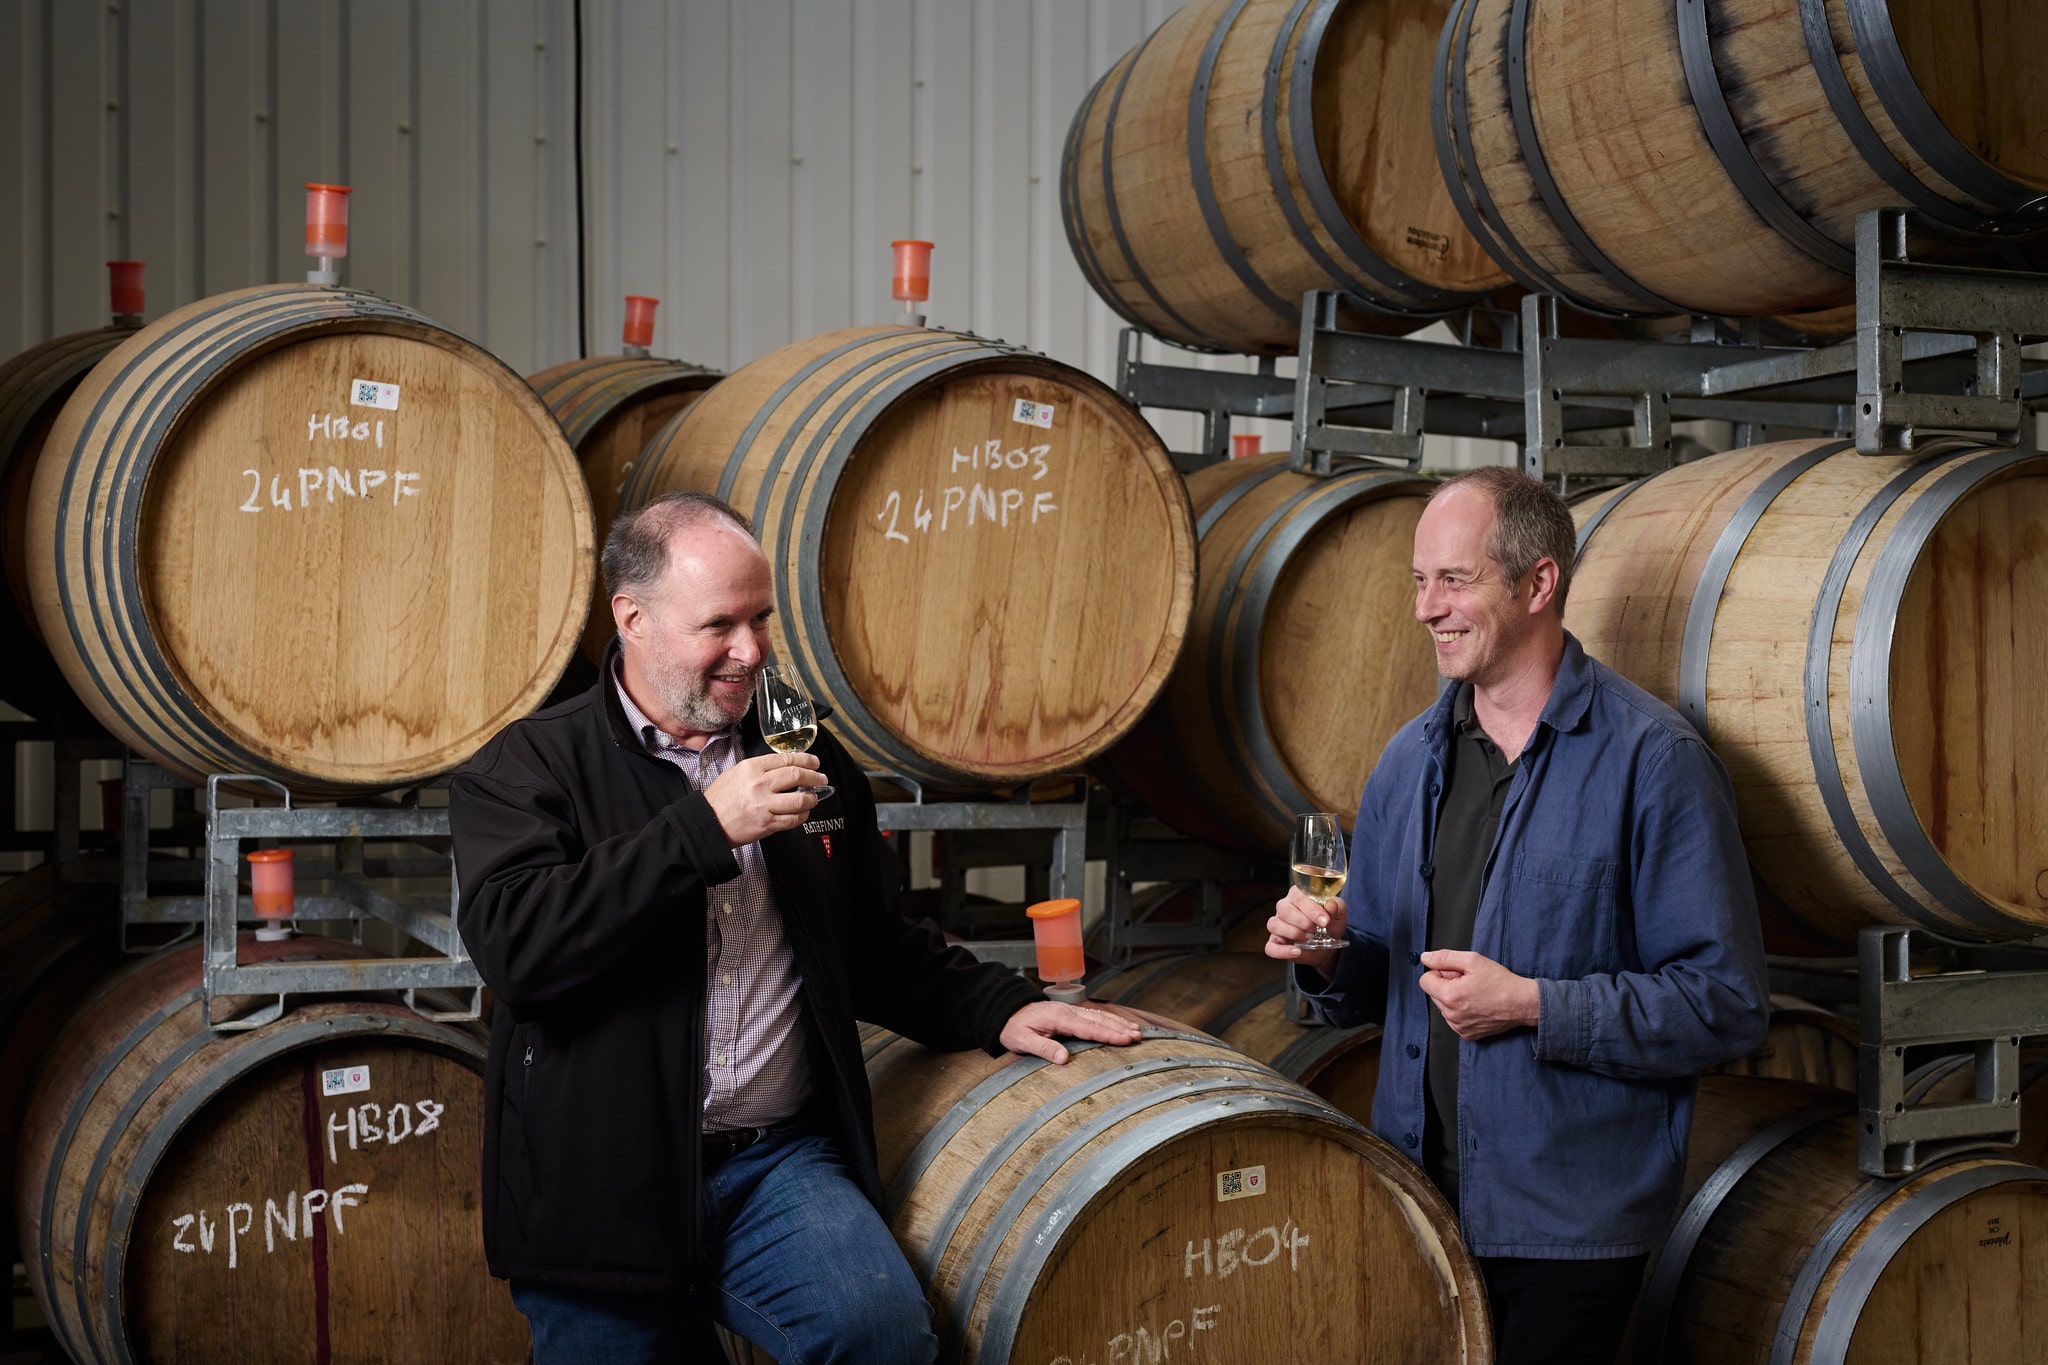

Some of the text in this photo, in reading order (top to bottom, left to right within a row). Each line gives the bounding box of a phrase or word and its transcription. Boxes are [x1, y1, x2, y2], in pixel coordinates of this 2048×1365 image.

[308, 413, 384, 449] HB01
[951, 439, 1051, 481] HB03
[239, 466, 422, 513] 24PNPF
[327, 1100, 444, 1164] HB08
[1184, 1216, 1313, 1280] HB04
[1049, 1303, 1222, 1365] PNPF
